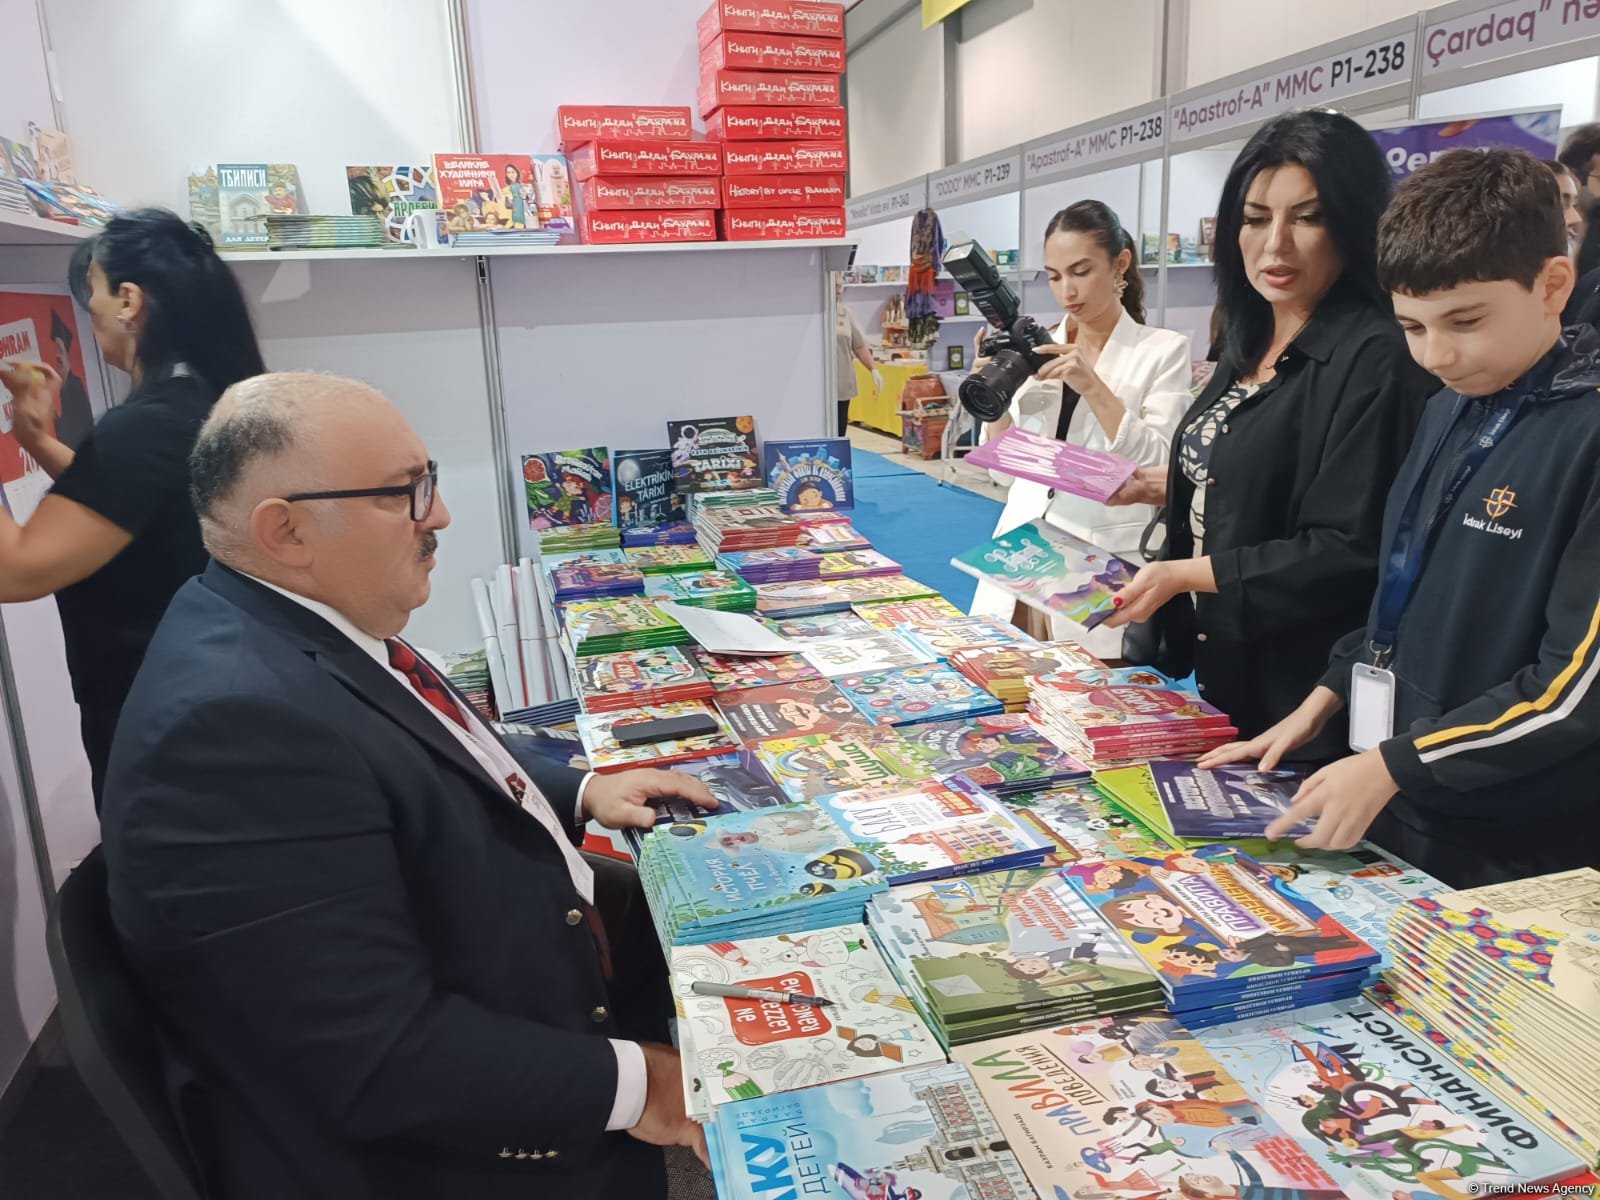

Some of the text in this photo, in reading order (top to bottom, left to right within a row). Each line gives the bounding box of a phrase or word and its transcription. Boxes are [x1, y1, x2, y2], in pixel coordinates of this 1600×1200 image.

[1276, 65, 1325, 101] MMC
[1331, 41, 1406, 85] P1-238
[1089, 131, 1118, 152] MMC
[1120, 117, 1163, 147] P1-238
[963, 172, 982, 190] MMC
[984, 163, 1011, 184] P1-239
[1176, 874, 1261, 932] ПРАВИЛА
[971, 1049, 1102, 1136] ПРАВИЛА
[1015, 1045, 1105, 1106] ПОВЕДЕНИЯ
[1346, 1011, 1539, 1150] ФИНАНСИСТ
[782, 1122, 831, 1194] ДЕТЕЙ
